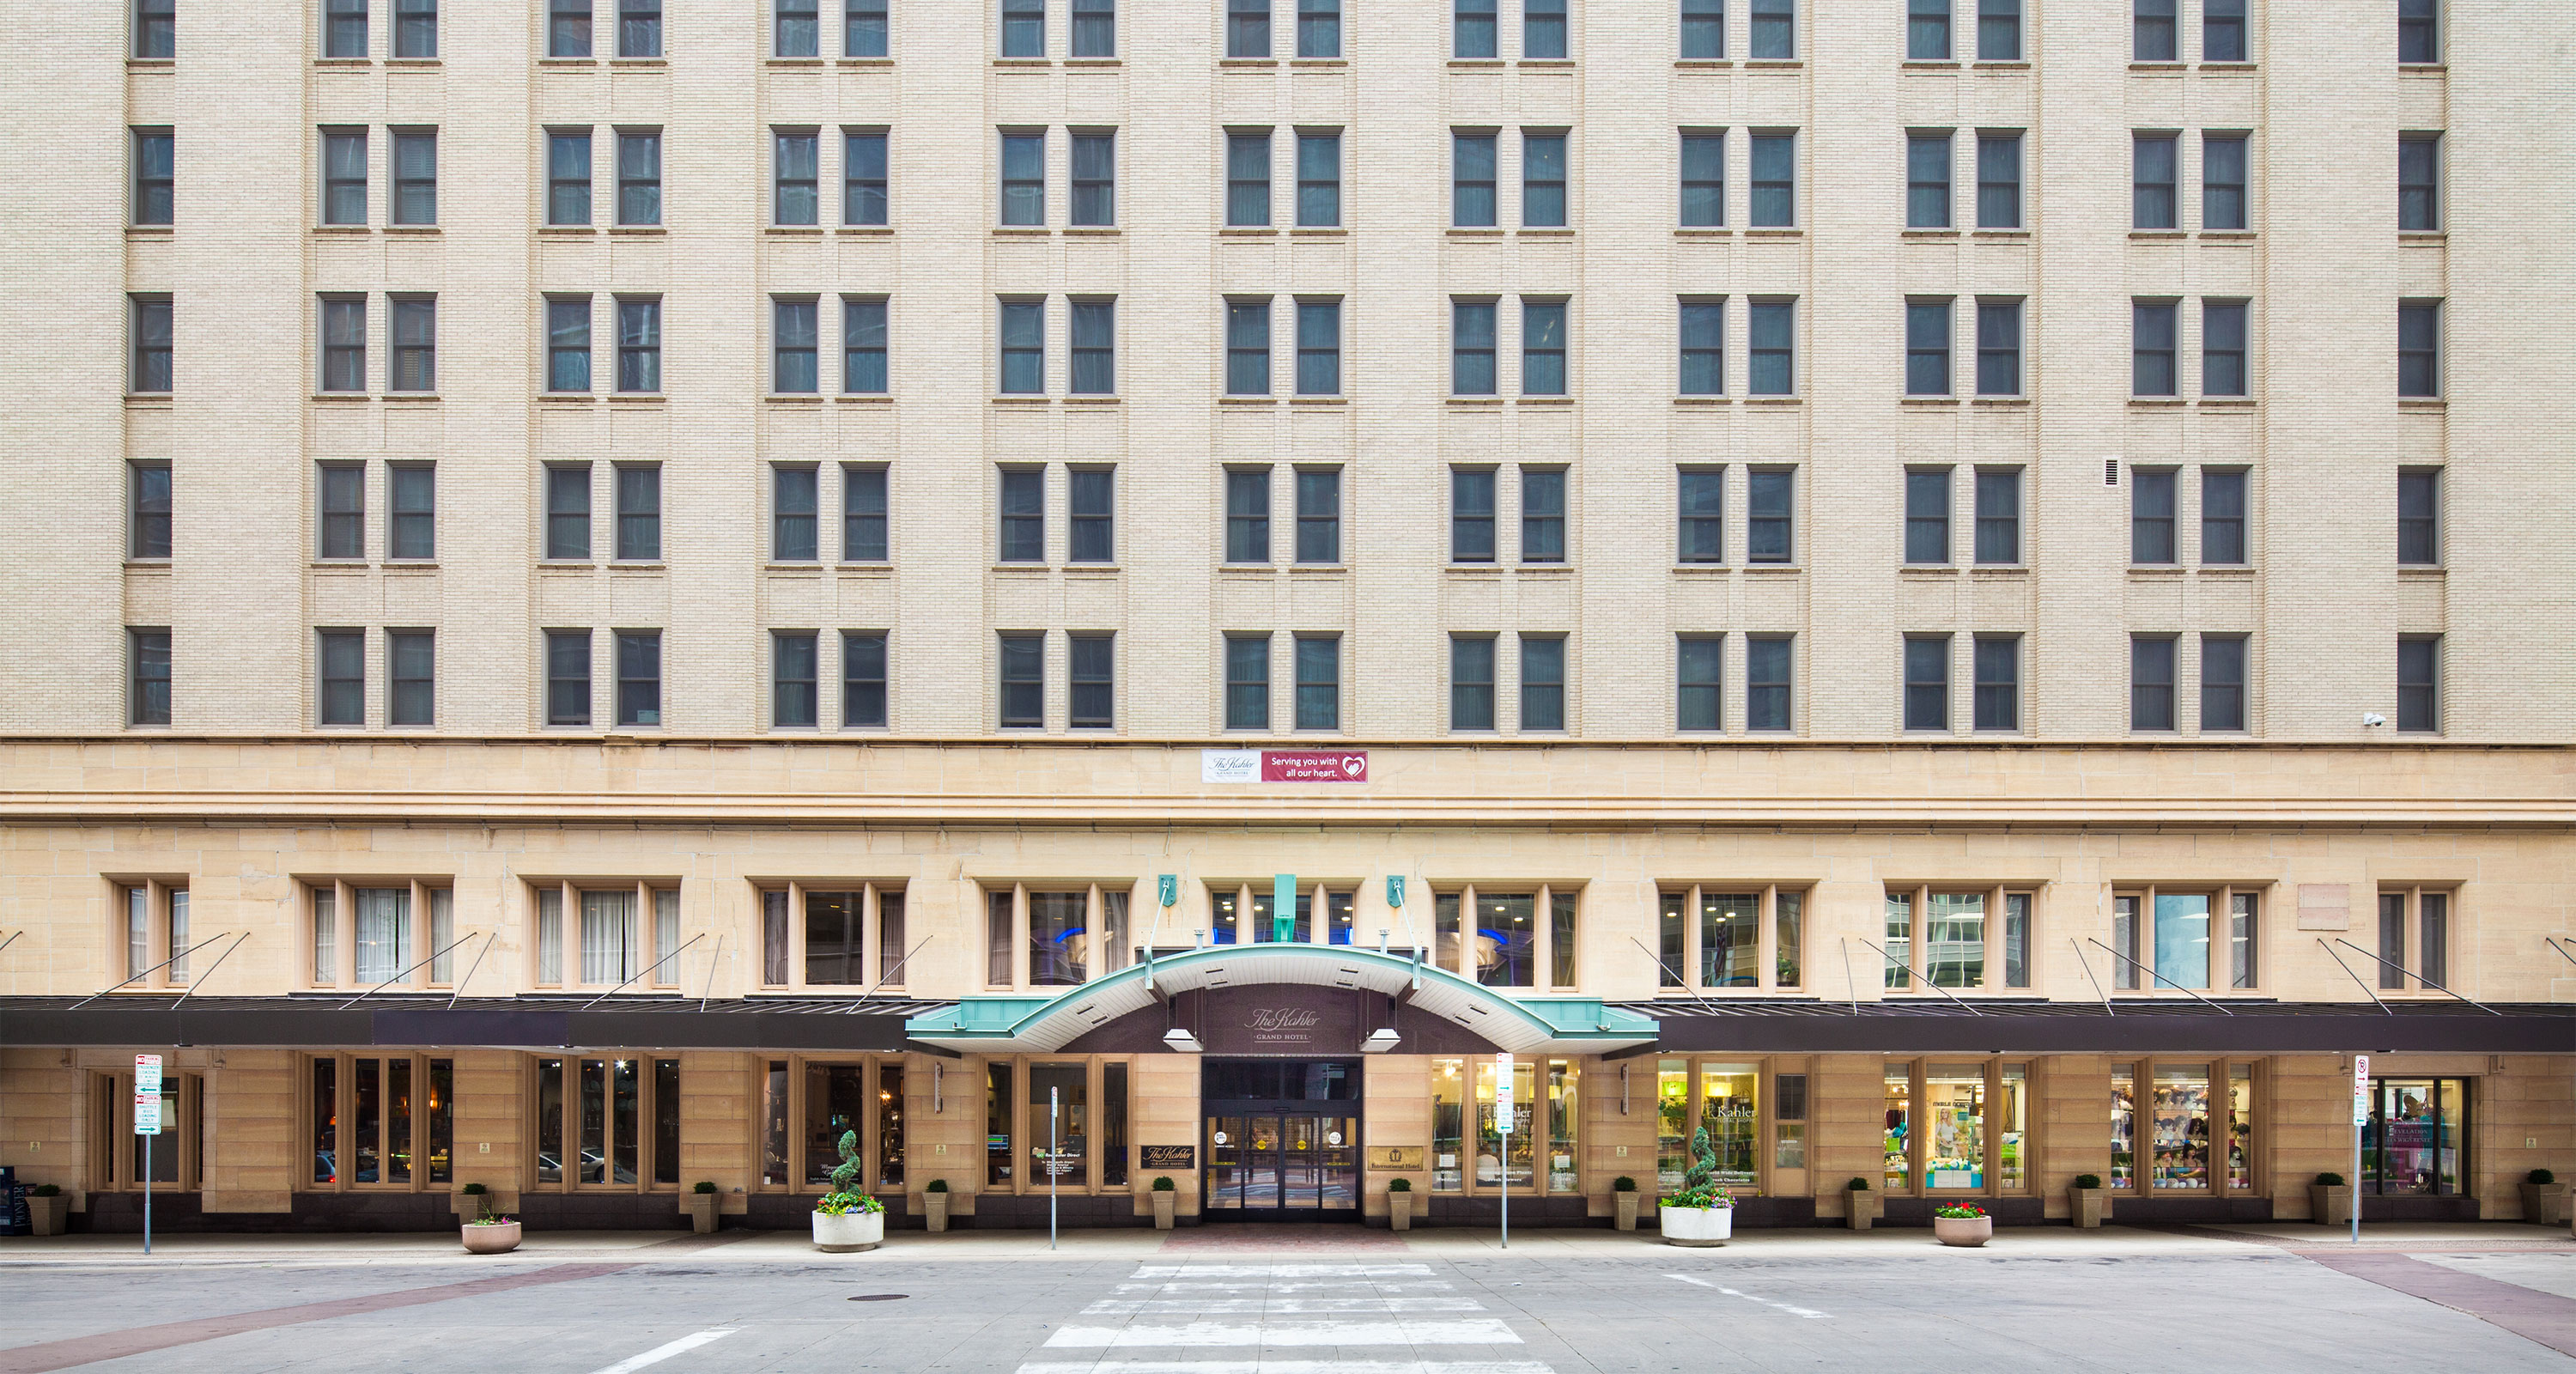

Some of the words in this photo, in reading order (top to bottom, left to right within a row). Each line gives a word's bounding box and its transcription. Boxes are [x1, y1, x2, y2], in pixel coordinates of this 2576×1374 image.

[1208, 757, 1227, 769] The
[1225, 757, 1255, 770] Kahler
[1272, 757, 1301, 767] Serving
[1320, 757, 1338, 765] with
[1244, 1009, 1275, 1028] The
[1267, 1008, 1321, 1031] Kahler
[1717, 1105, 1756, 1117] Kahler
[1143, 1146, 1163, 1160] The
[1157, 1146, 1193, 1162] Kahler
[14, 1186, 26, 1227] PIONEER
